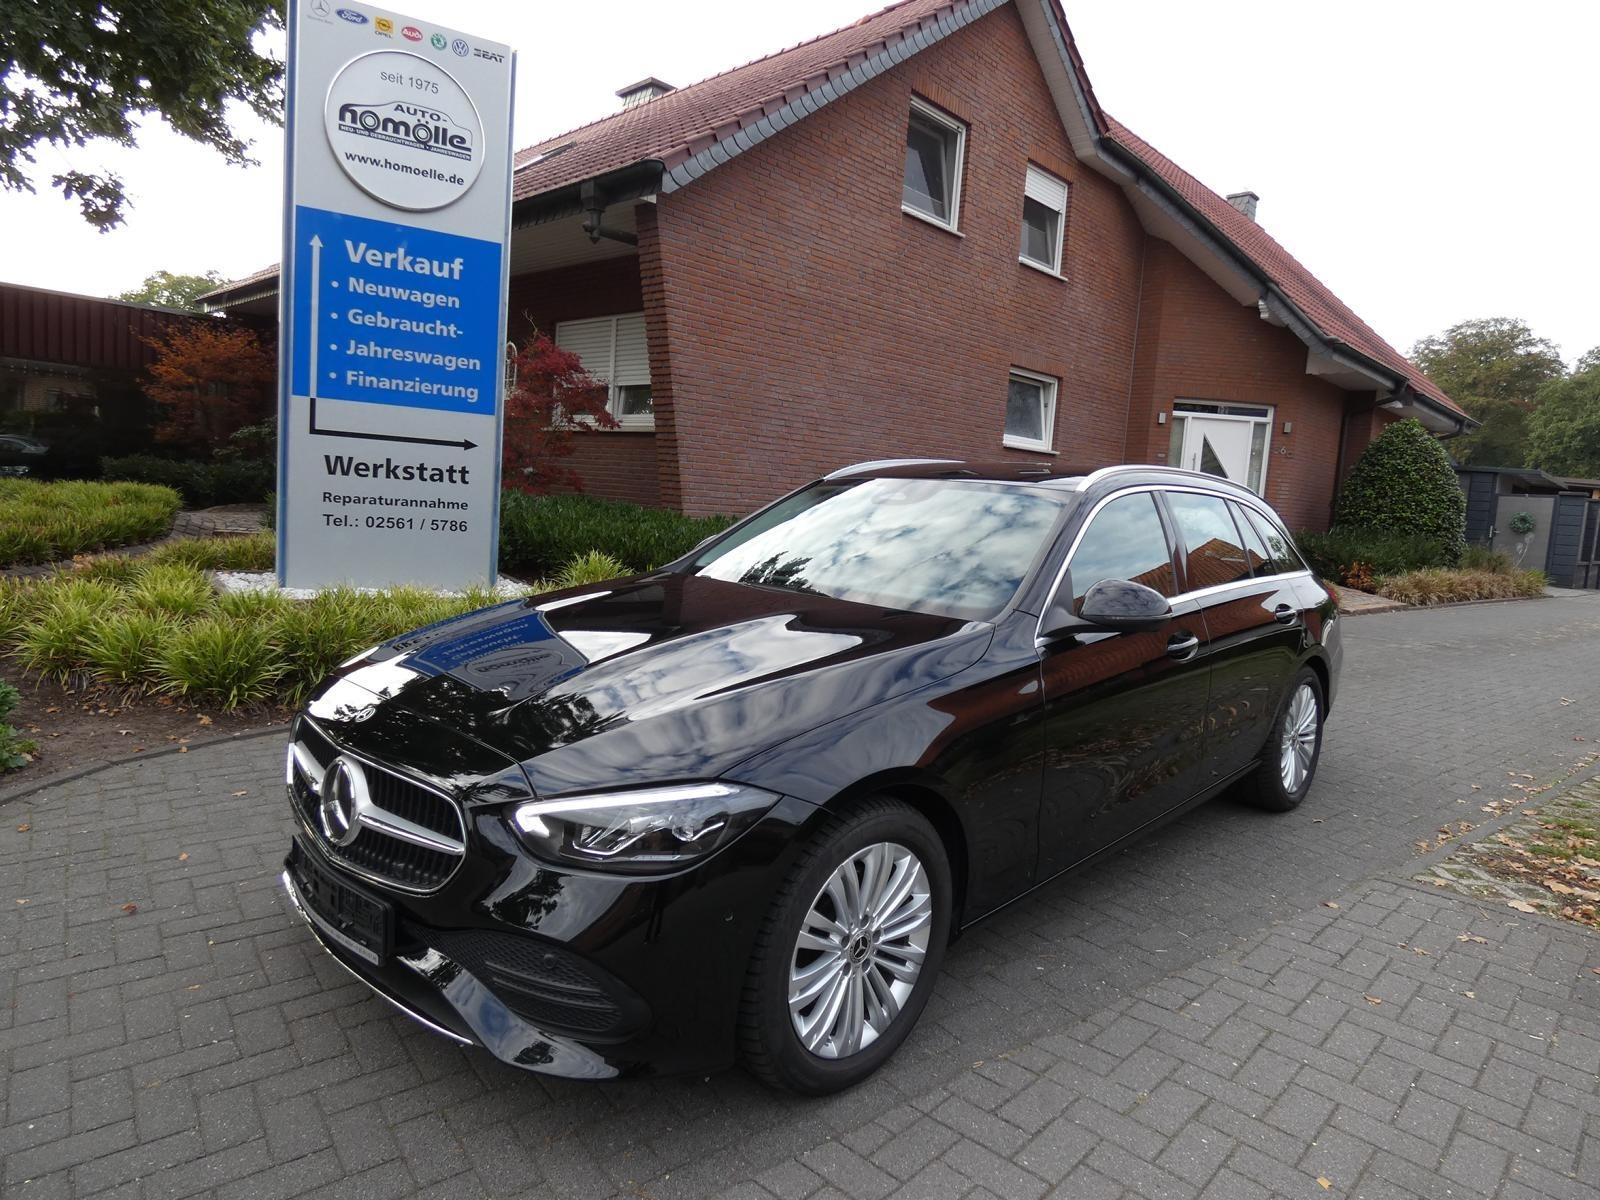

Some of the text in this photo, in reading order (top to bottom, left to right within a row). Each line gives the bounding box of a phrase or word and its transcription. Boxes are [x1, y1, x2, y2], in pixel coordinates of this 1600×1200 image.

[474, 48, 504, 64] SEAT
[380, 71, 439, 94] seit 1975
[394, 104, 448, 122] AUTO-
[345, 152, 465, 186] www.homoelle.de
[345, 239, 464, 281] Verkauf
[348, 277, 460, 308] Neuwagen
[347, 308, 464, 338] Gebraucht-
[346, 340, 481, 371] Jahreswagen
[346, 370, 480, 403] Finanzierung
[324, 454, 470, 485] Werkstatt
[322, 491, 469, 511] Reparaturannahme
[322, 514, 468, 532] Tel.: 02561 / 5786
